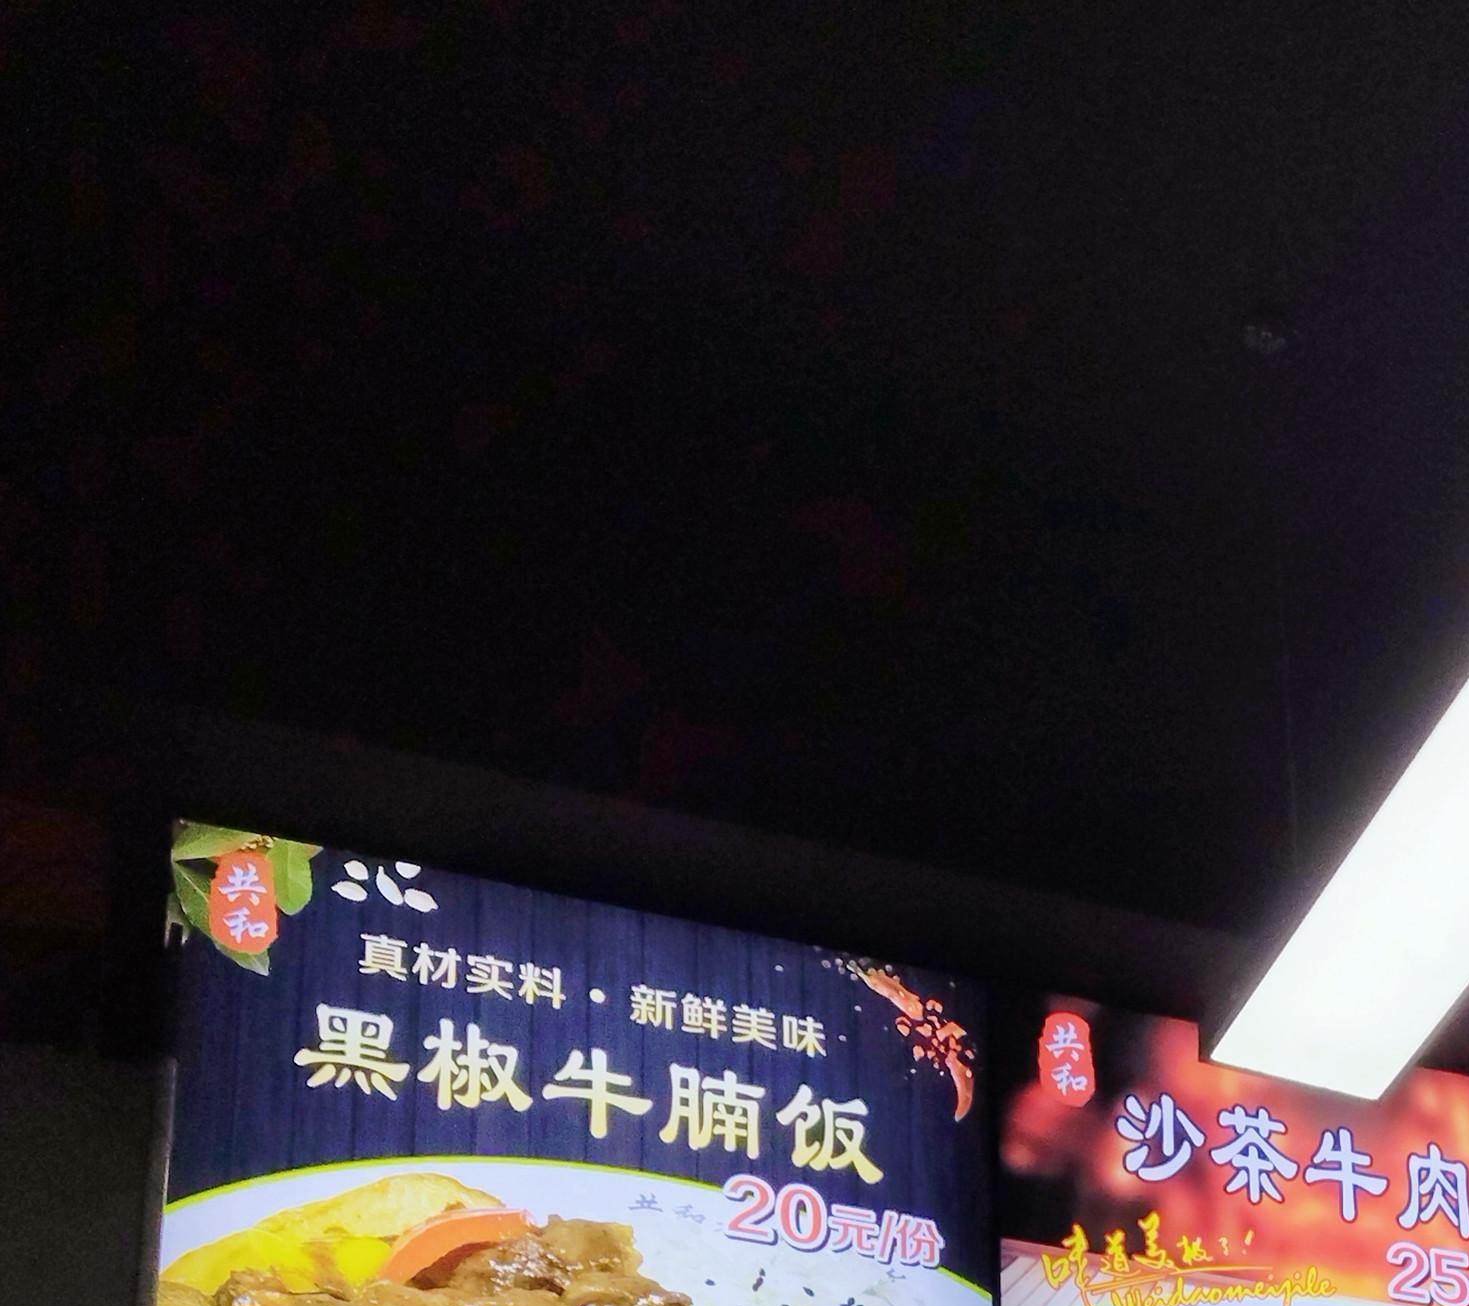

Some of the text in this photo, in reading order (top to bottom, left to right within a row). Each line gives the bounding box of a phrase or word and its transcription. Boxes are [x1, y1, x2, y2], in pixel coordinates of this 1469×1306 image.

[218, 864, 270, 944] 共和
[294, 1002, 885, 1184] 黑椒牛腩饭
[1045, 1024, 1089, 1097] 共和
[722, 1173, 946, 1270] 20元/份
